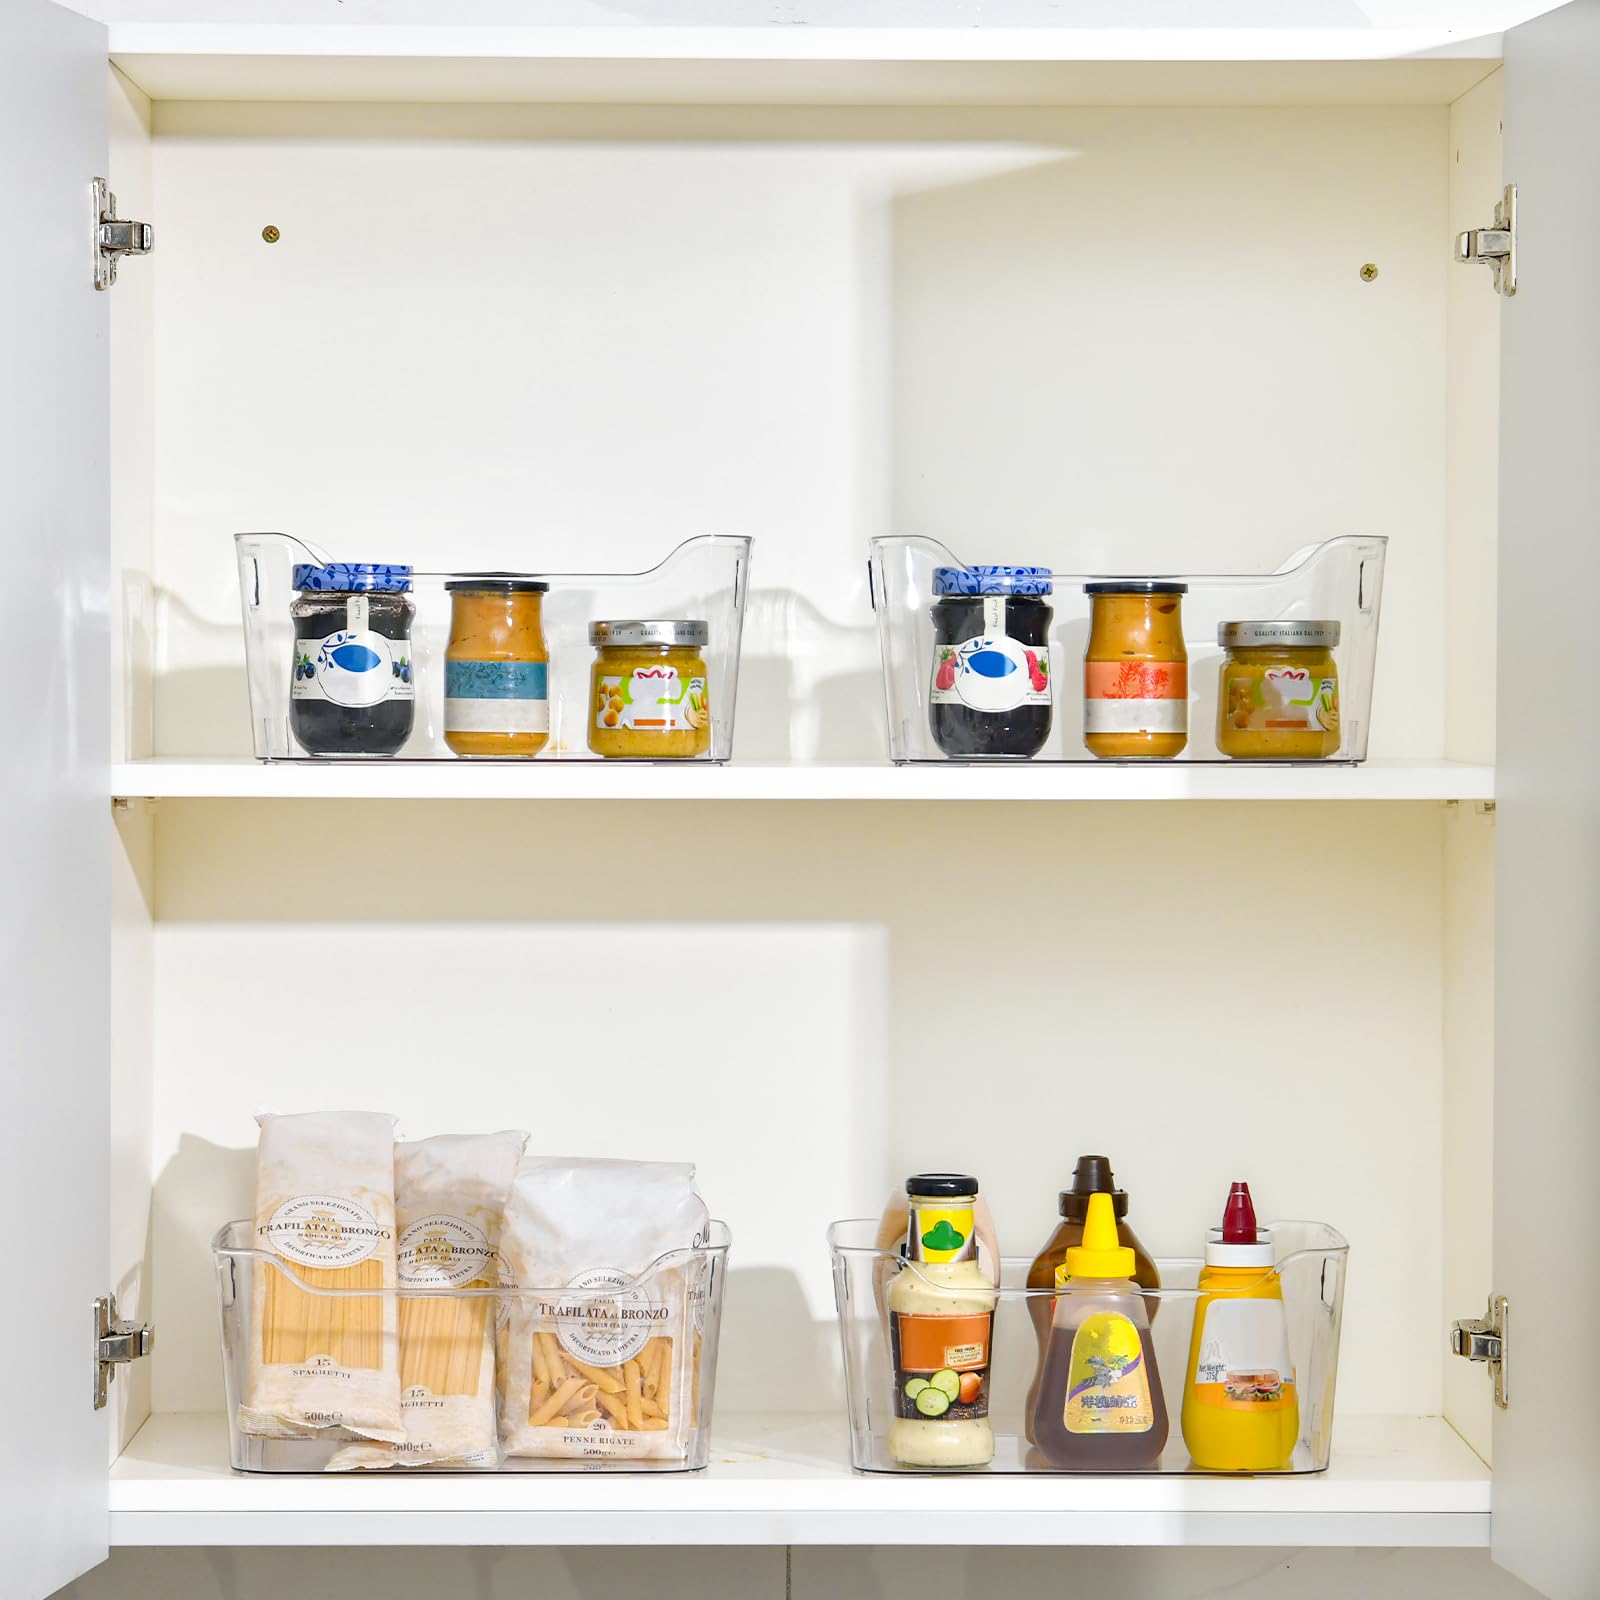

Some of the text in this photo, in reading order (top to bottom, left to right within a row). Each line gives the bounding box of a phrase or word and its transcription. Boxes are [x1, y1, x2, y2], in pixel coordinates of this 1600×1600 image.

[284, 1200, 363, 1220] GRANO SELEZIONATO
[257, 1222, 328, 1236] TRAFILATA
[341, 1226, 391, 1240] BRONZO
[424, 1220, 475, 1240] SELEZIONATO
[284, 1241, 333, 1260] DECORTICATO
[342, 1244, 366, 1259] PIETRA
[397, 1246, 438, 1260] FILATA
[448, 1265, 473, 1280] PIETRA
[539, 1303, 608, 1319] TRAFILATA
[621, 1308, 668, 1320] BRONZO
[569, 1332, 611, 1356] DECORTICATO
[618, 1333, 639, 1353] PIETRA
[316, 1358, 331, 1366] 15
[292, 1369, 350, 1379] SPAGHETTI
[410, 1390, 425, 1398] 15
[593, 1423, 606, 1431] 20
[563, 1436, 635, 1446] PENNE RIGATE
